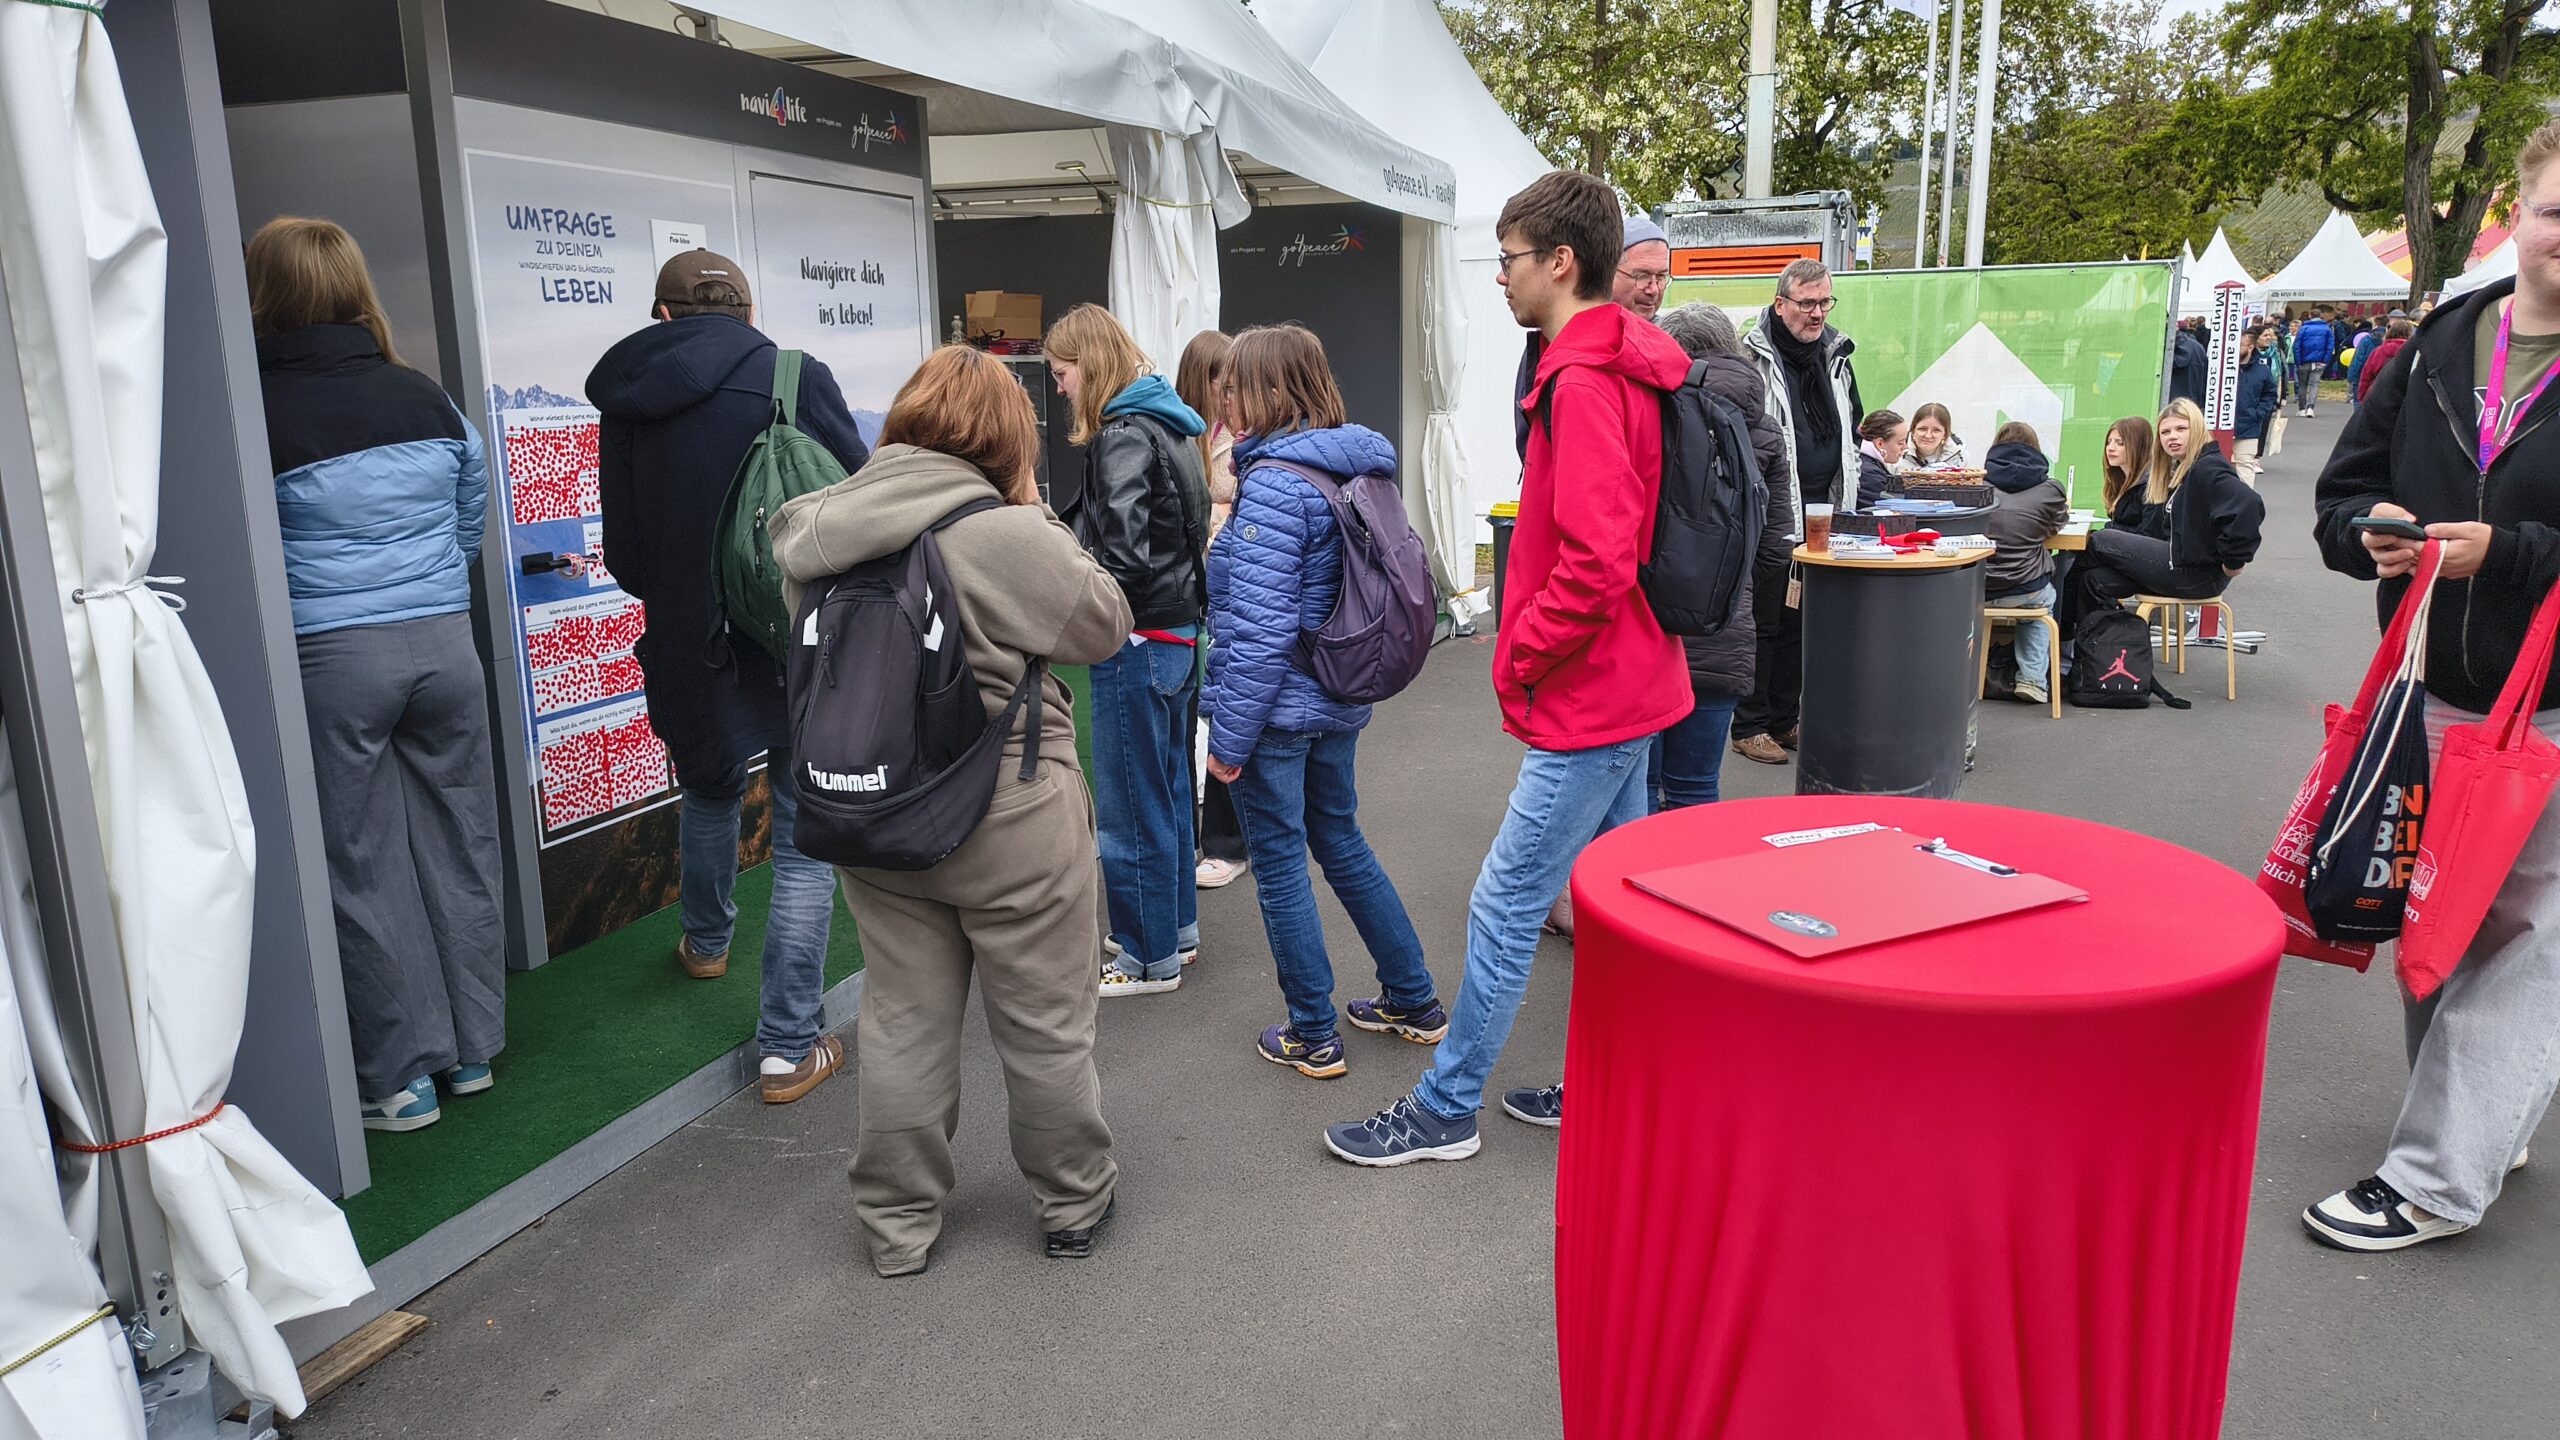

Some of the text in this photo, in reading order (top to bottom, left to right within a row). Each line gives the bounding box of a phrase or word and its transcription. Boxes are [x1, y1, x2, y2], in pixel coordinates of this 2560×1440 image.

[740, 86, 808, 126] navi4life
[851, 112, 892, 152] go4peace
[1383, 164, 1417, 196] go4peace
[1418, 174, 1431, 199] e.V.
[506, 205, 616, 238] UMFRAGE
[535, 240, 603, 258] ZU DEINEM
[1278, 233, 1342, 267] go4peace
[564, 263, 577, 272] UND
[800, 256, 884, 290] Navigiere dich
[541, 276, 613, 304] LEBEN
[818, 303, 835, 326] ins
[2211, 291, 2226, 333] Мир
[2211, 338, 2220, 360] на
[2221, 291, 2242, 428] Friede auf Erden!
[2100, 683, 2138, 691] AIR
[807, 762, 887, 792] hummel
[2373, 820, 2418, 853] BEI
[2355, 897, 2384, 908] GOTT
